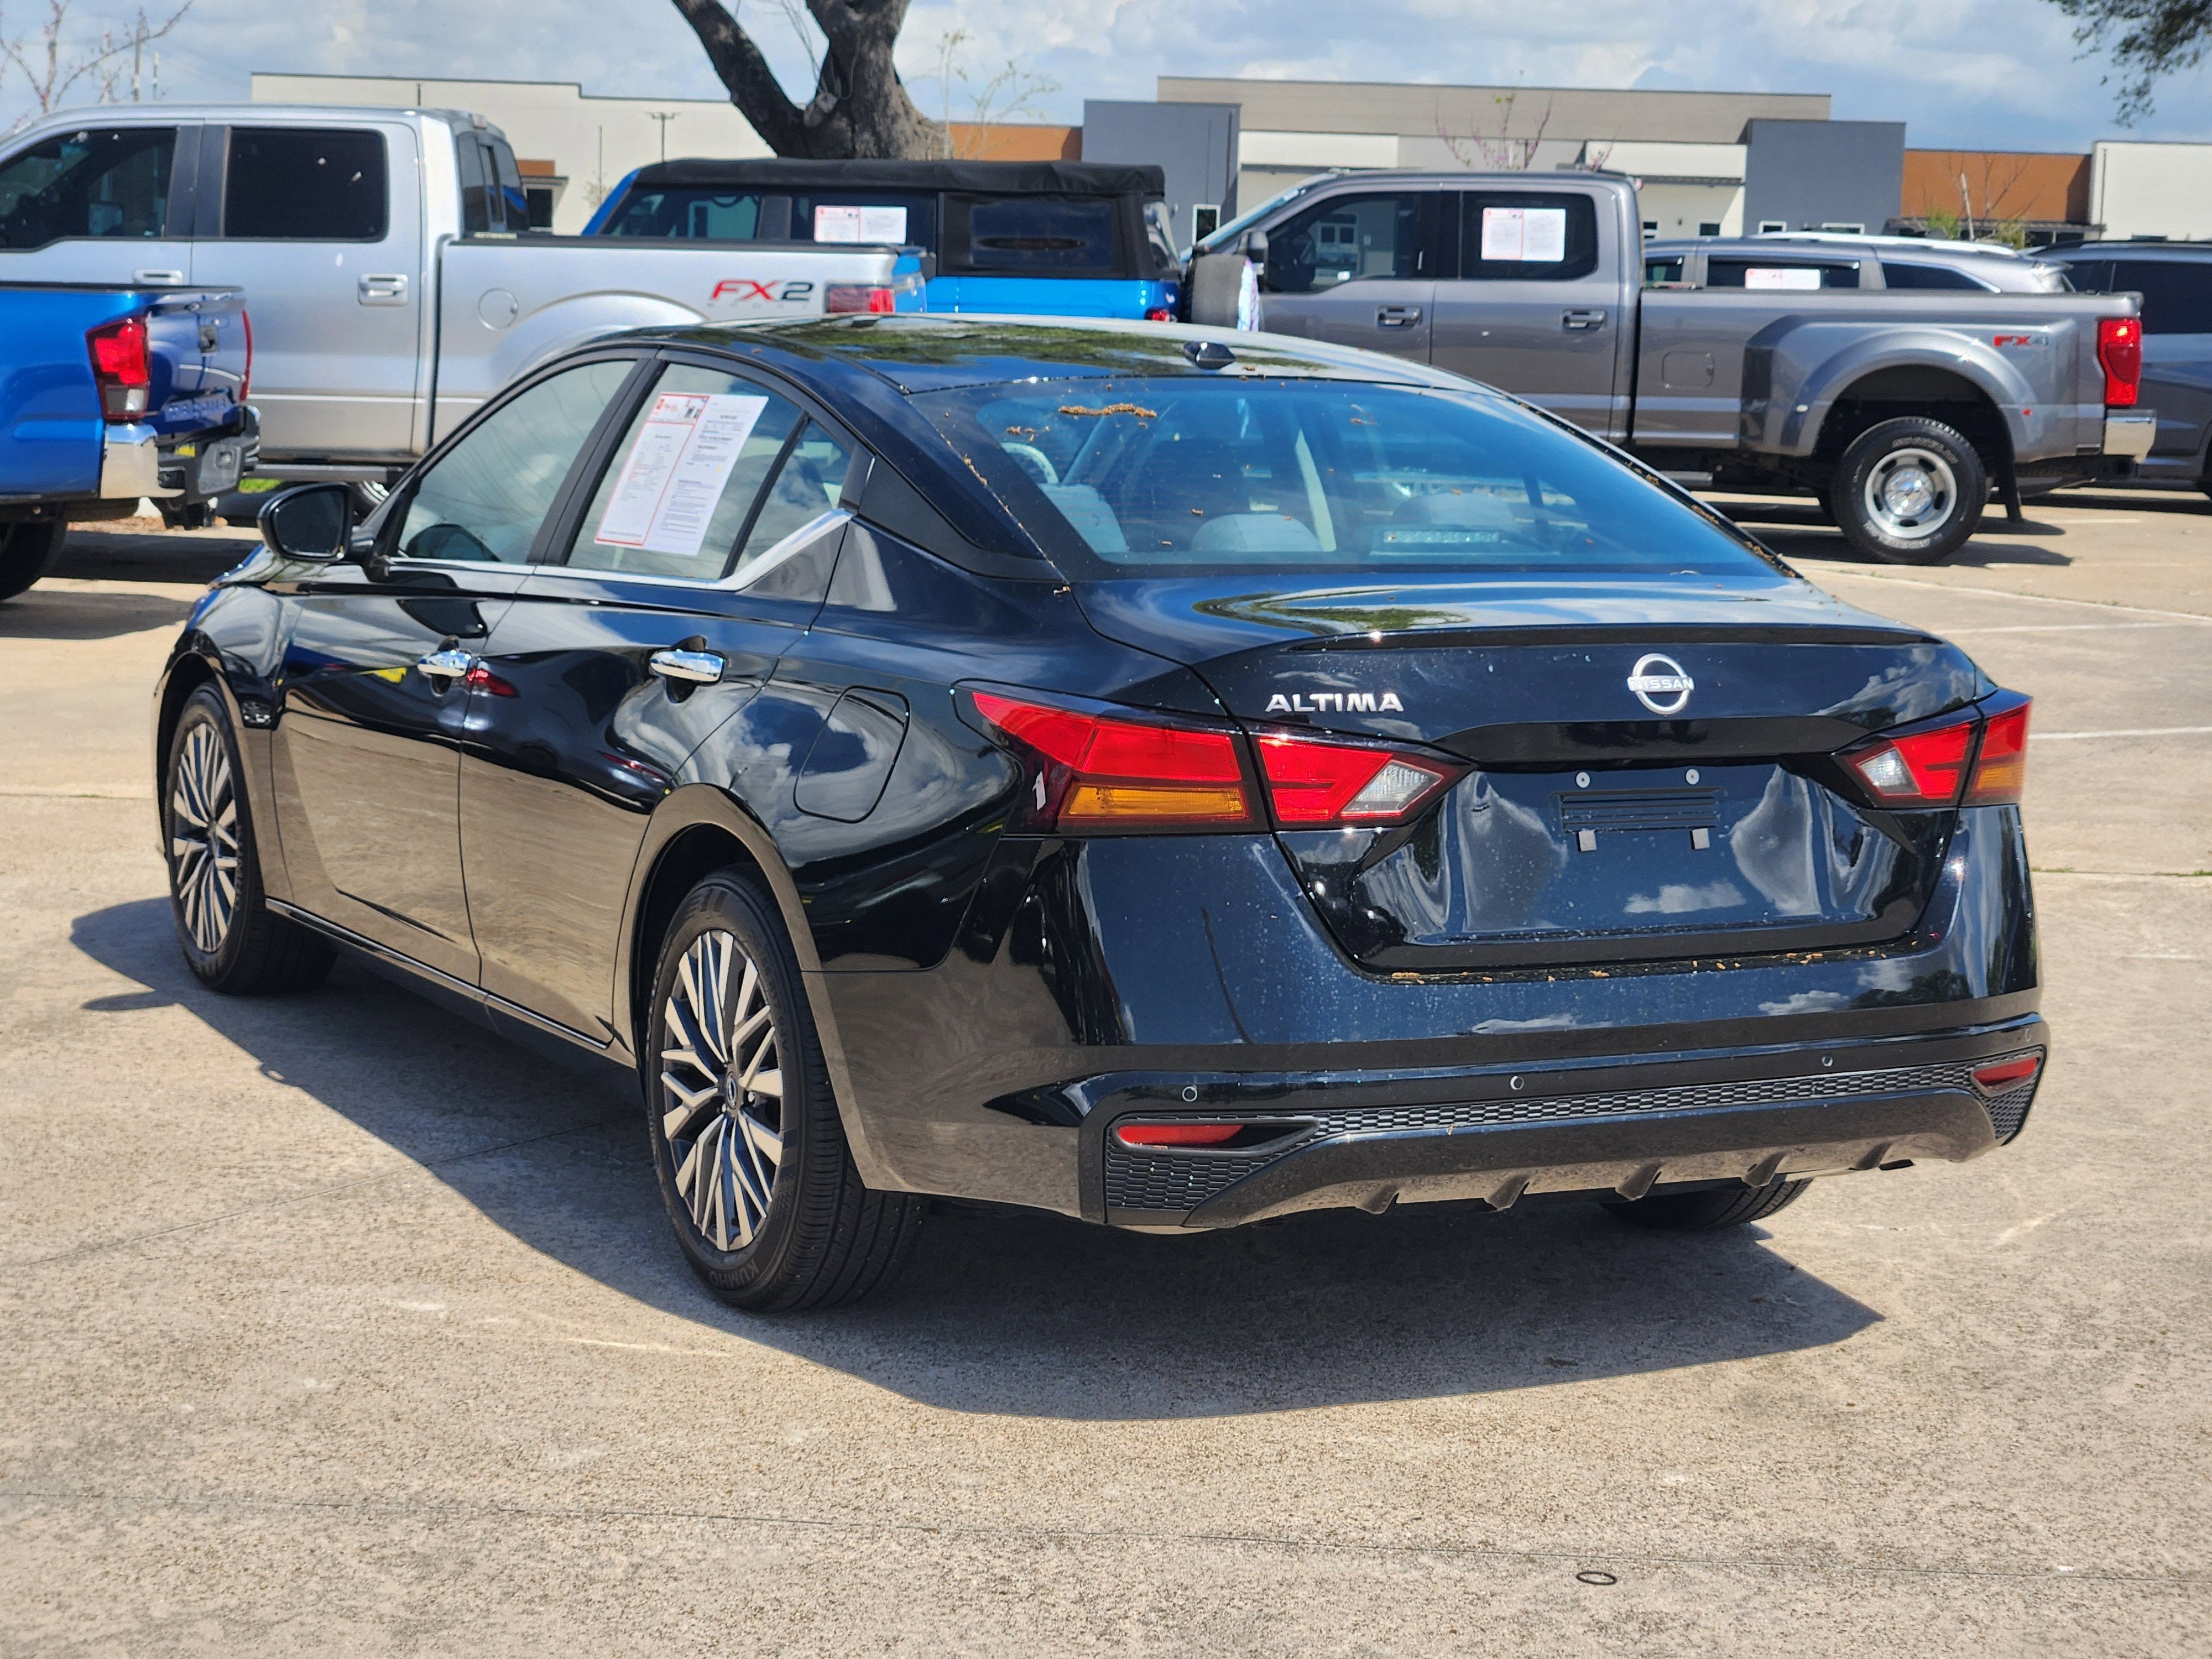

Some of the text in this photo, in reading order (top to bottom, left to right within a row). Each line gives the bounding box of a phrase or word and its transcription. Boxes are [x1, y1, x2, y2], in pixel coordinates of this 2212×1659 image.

[709, 279, 815, 301] FX2
[1993, 335, 2049, 347] FX4
[1629, 678, 1693, 690] NISSAN
[1265, 692, 1405, 713] ALTIMA
[708, 1258, 759, 1289] KUMHO
